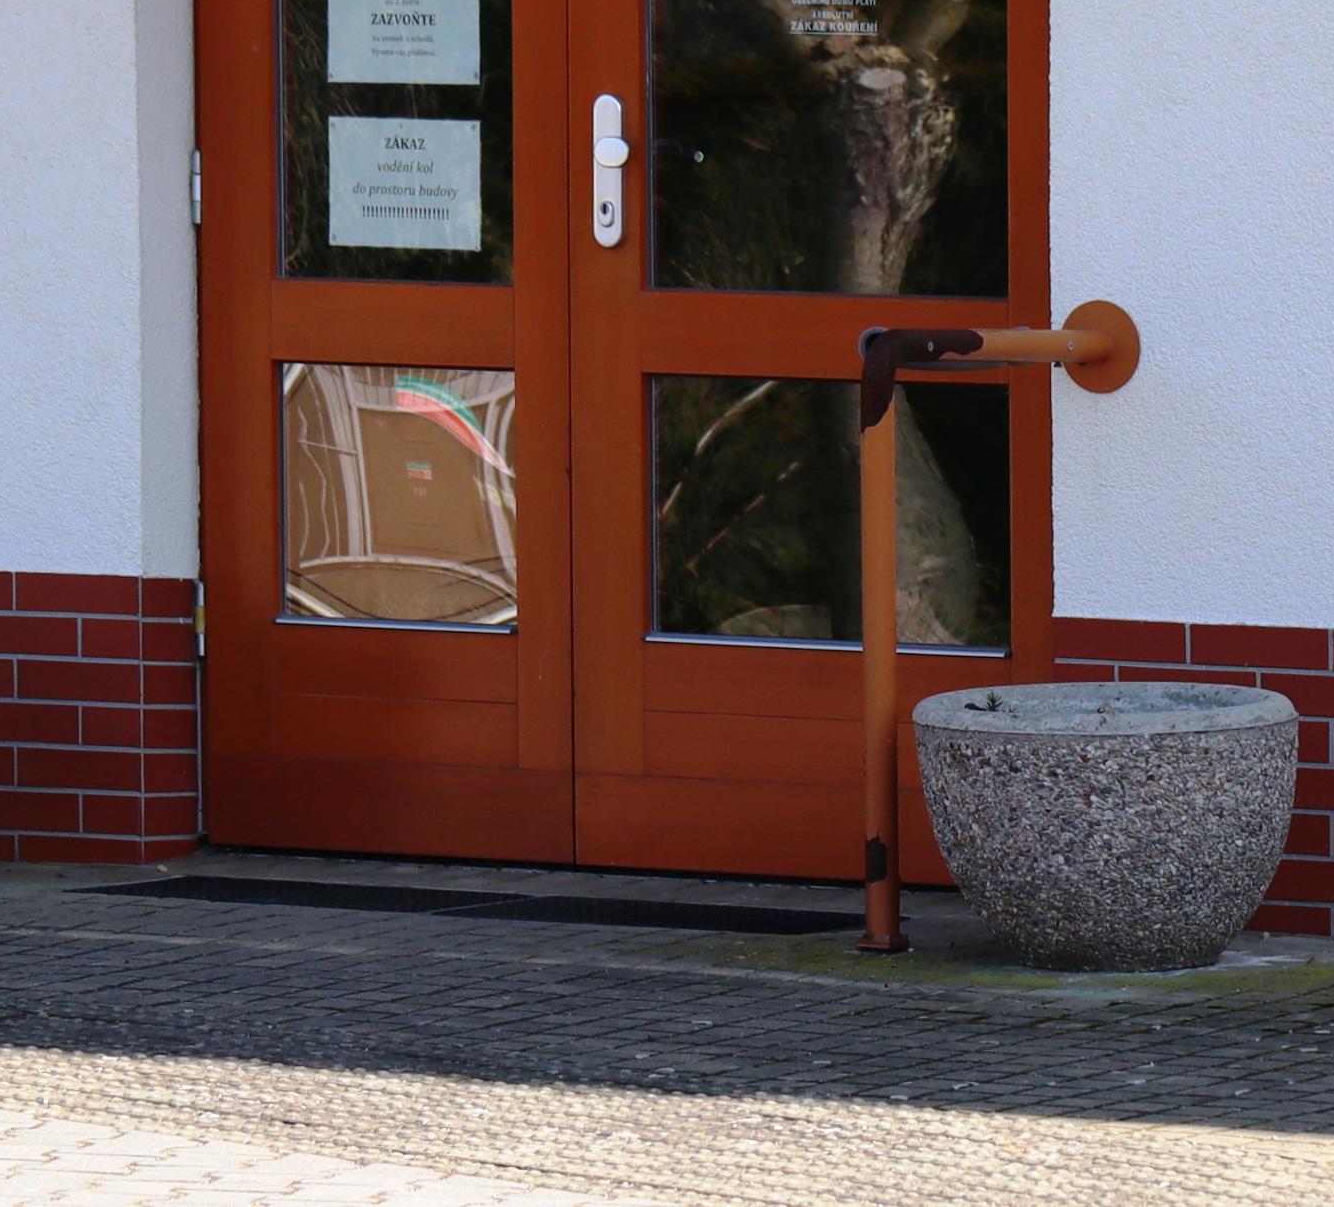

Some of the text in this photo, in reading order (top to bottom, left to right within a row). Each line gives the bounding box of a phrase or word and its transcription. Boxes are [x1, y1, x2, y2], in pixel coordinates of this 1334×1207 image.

[371, 11, 437, 26] ZAZVOŇTE
[790, 18, 878, 32] ZÁKAZ KOUŘENÍ
[384, 134, 426, 150] ZÁKAZ
[377, 160, 434, 173] vodění kol
[352, 182, 459, 201] do prostoru budovy
